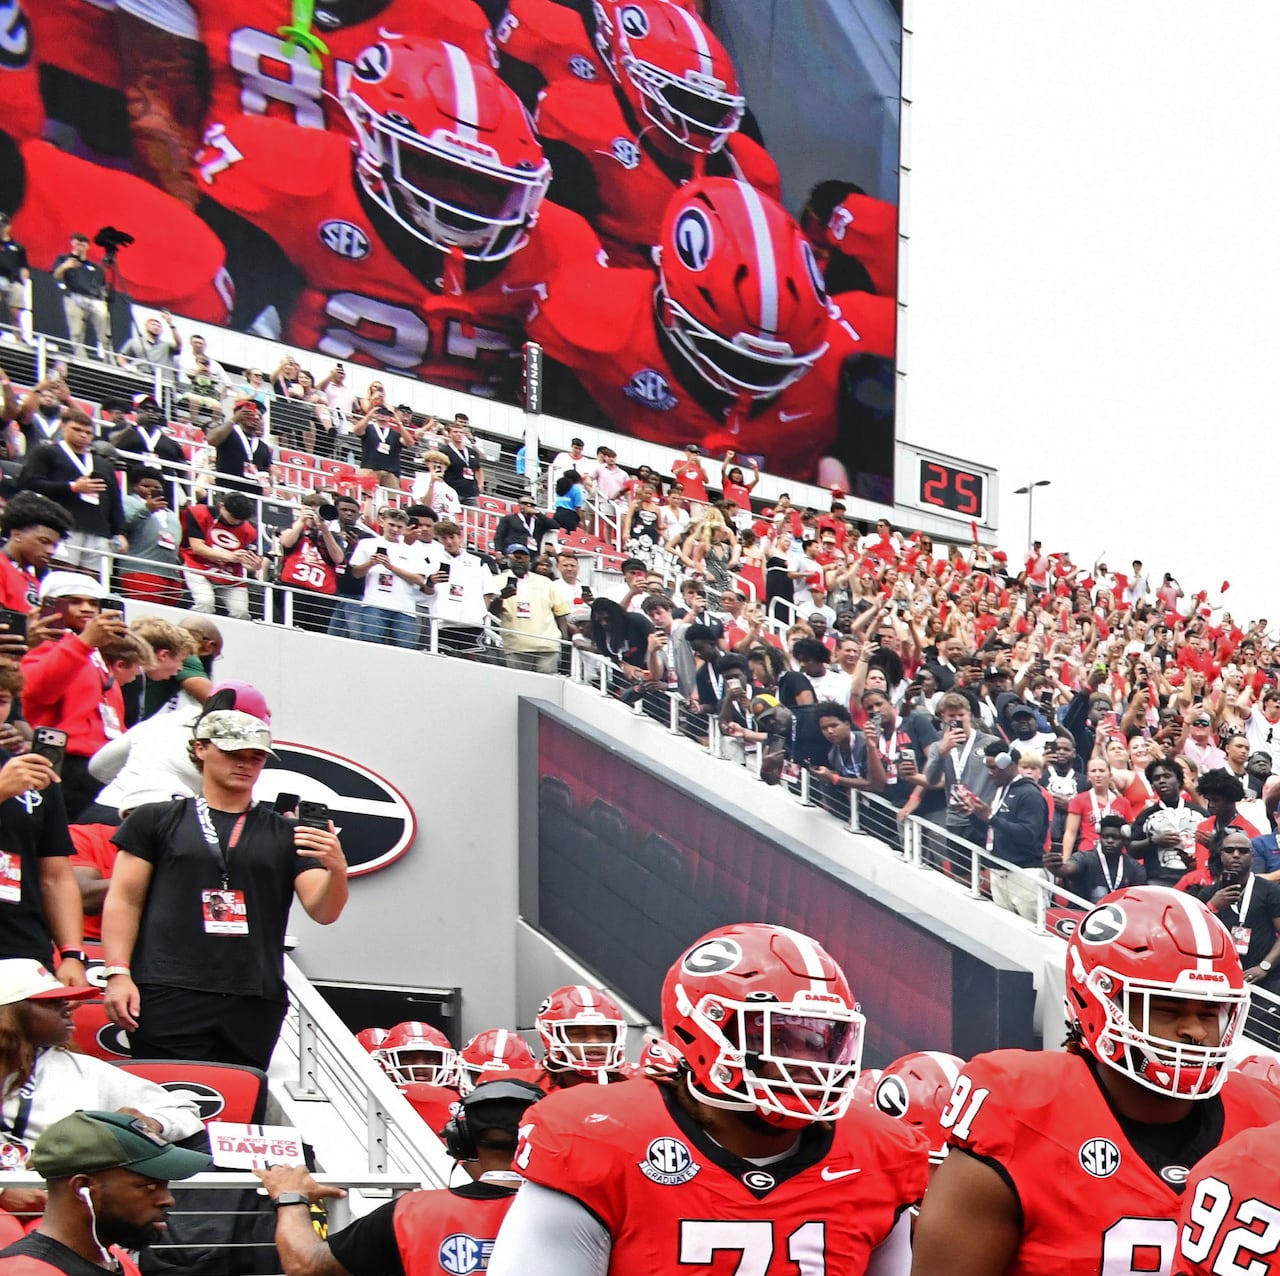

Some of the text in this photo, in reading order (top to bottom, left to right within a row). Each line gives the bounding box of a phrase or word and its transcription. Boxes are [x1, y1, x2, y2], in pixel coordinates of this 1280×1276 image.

[320, 222, 369, 259] SEC
[632, 370, 668, 403] SEC
[924, 464, 977, 514] 25
[292, 563, 326, 588] 30
[1189, 972, 1225, 983] DAWGS
[938, 1074, 990, 1141] 91
[217, 1140, 299, 1157] DAWGS
[648, 1138, 691, 1173] SEC
[1080, 1139, 1120, 1177] SEC
[643, 1163, 697, 1186] GRADUATE
[743, 1171, 775, 1190] G
[441, 1236, 480, 1274] SEC
